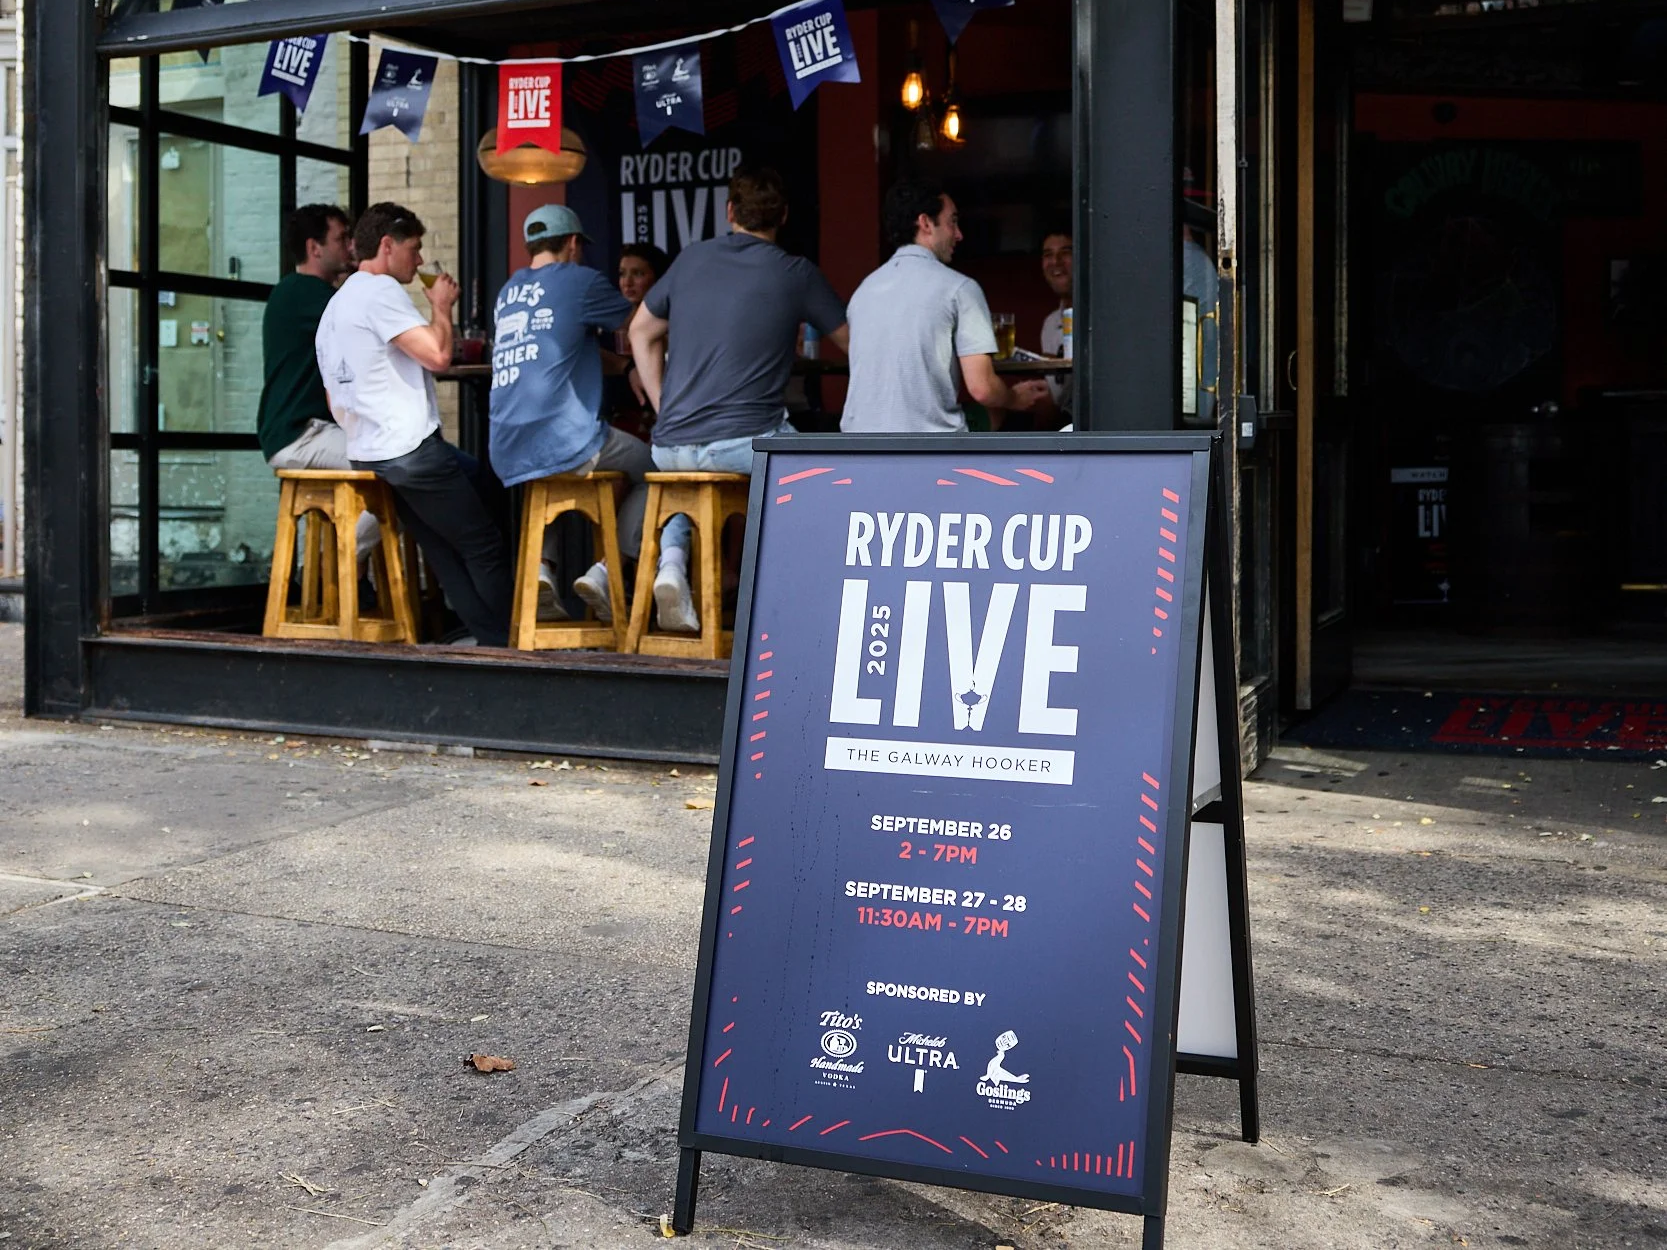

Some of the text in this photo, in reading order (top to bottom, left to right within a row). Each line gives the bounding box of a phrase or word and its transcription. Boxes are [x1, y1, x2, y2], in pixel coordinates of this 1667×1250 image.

[785, 12, 833, 41] RYDER CUP
[273, 41, 315, 79] LIVE
[788, 24, 841, 71] LIVE
[508, 75, 551, 90] RYDER CUP
[507, 88, 551, 120] LIVE
[620, 147, 742, 186] RYDER CUP
[845, 511, 1093, 572] RYDER CUP
[866, 605, 891, 676] 2025
[829, 578, 1088, 736] LIVE
[847, 748, 1052, 773] THE GALWAY HOOKER
[870, 814, 1012, 840] SEPTEMBER 26
[898, 841, 912, 859] 2
[933, 844, 978, 864] 7PM
[844, 880, 957, 906] SEPTEMBER
[961, 891, 985, 908] 27
[1002, 894, 1027, 912] 28
[857, 906, 942, 931] 11:30AM
[964, 916, 1009, 937] 7PM
[866, 981, 986, 1006] SPONSORED BY
[819, 1010, 863, 1030] Tito's
[898, 1032, 948, 1048] Michelob
[809, 1055, 864, 1074] Handmade
[888, 1044, 958, 1070] ULTRA
[822, 1071, 849, 1082] VODKA
[976, 1081, 1031, 1104] Goslings
